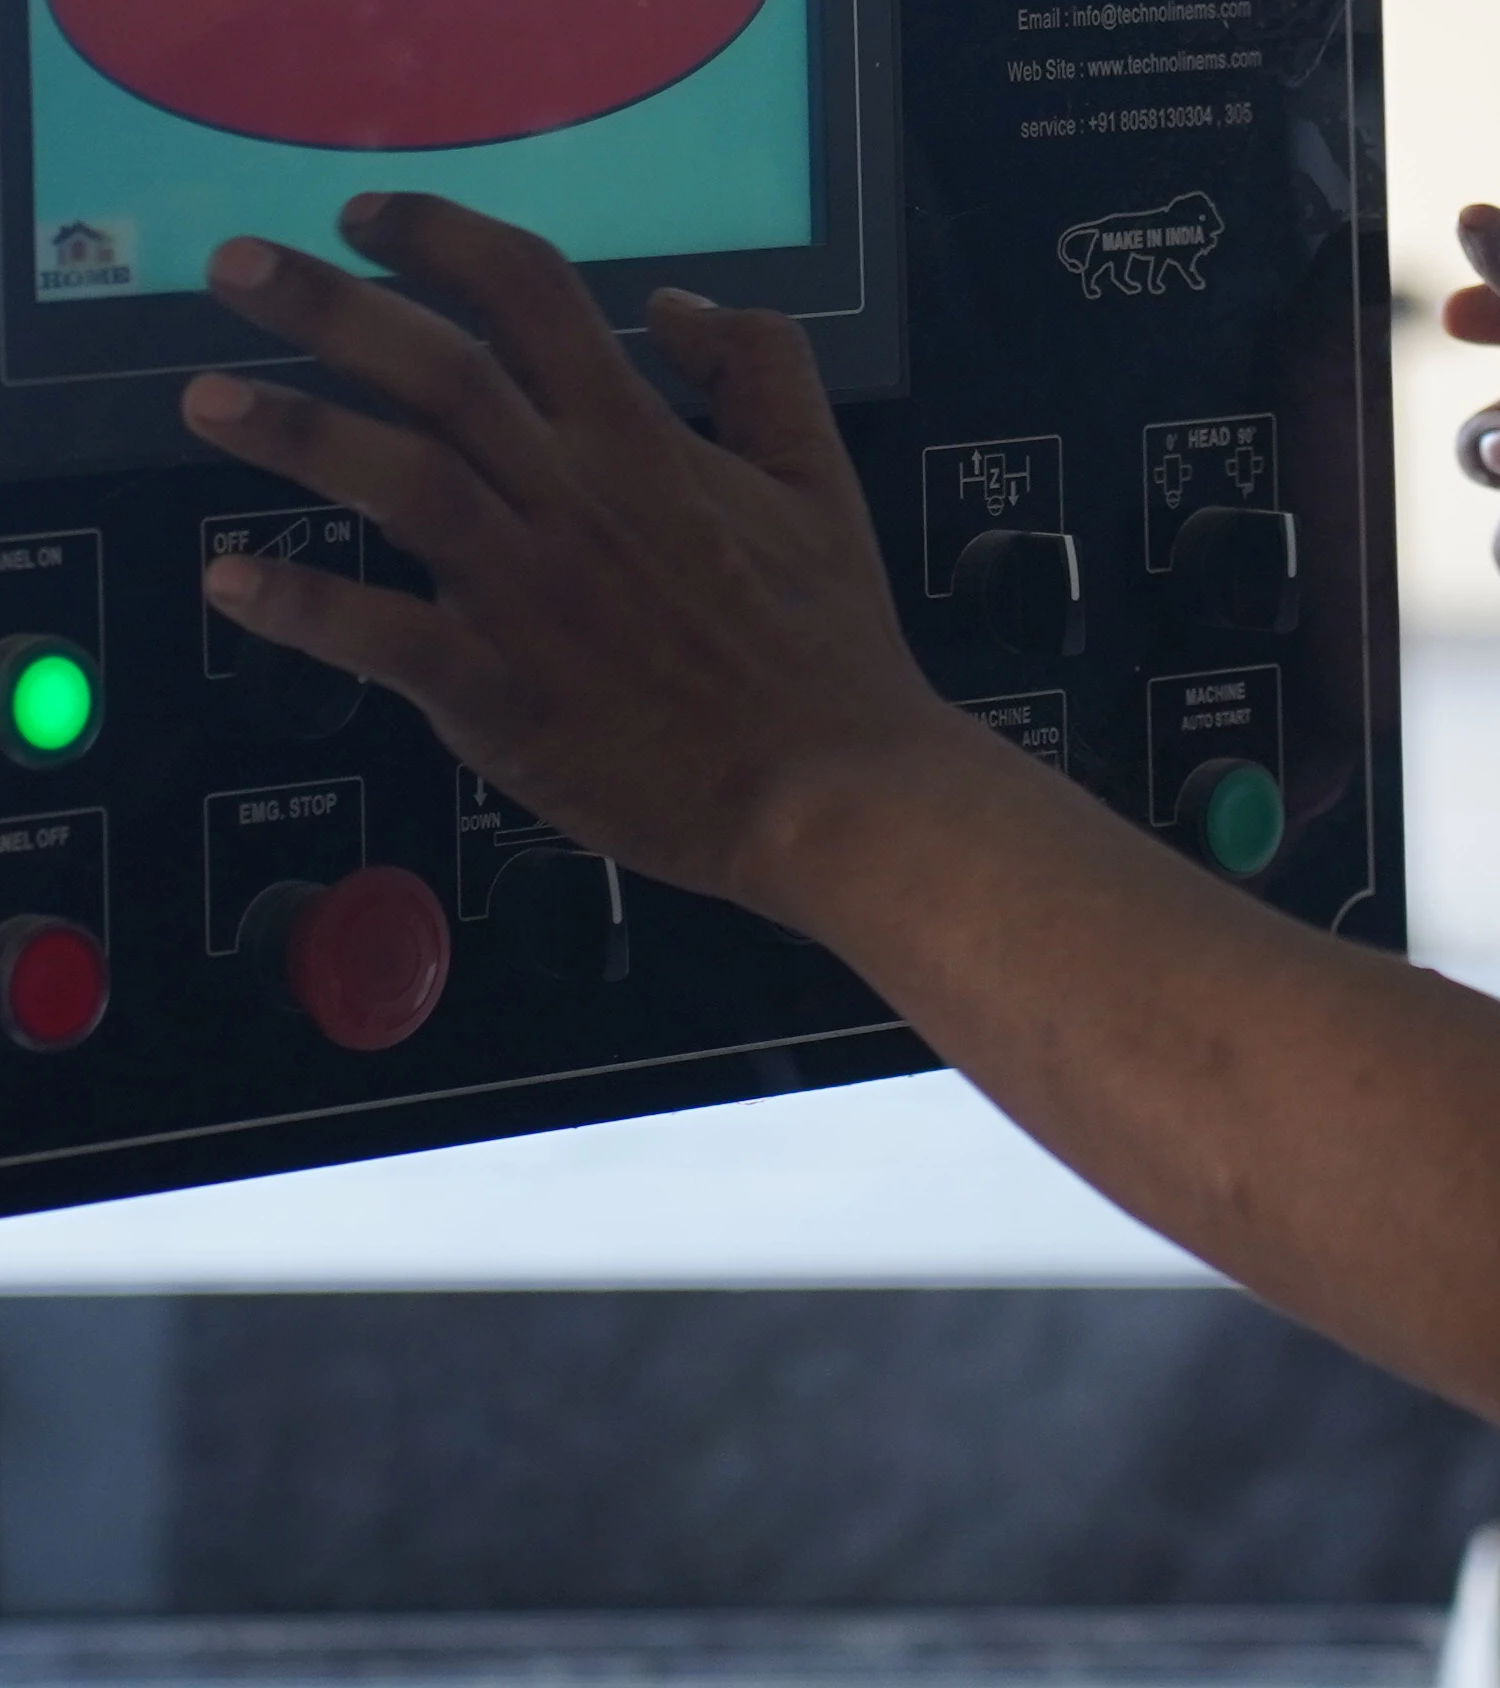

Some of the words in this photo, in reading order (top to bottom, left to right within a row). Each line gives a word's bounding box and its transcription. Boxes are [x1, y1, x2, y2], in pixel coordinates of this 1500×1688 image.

[1018, 8, 1060, 31] Email
[1072, 0, 1252, 31] info@technolinems.com
[1007, 60, 1042, 82] Web
[1045, 58, 1076, 80] Site
[1087, 49, 1262, 77] www.technolinems.com
[1020, 115, 1076, 139] service
[1120, 105, 1212, 132] 8058130304
[1224, 102, 1253, 125] 305
[1102, 230, 1144, 251] MAKE
[1146, 228, 1162, 248] IN
[1165, 225, 1205, 246] INDIA
[41, 264, 130, 290] HOME
[1188, 426, 1231, 448] HEAD
[989, 468, 1000, 489] Z
[213, 530, 249, 554] OFF
[324, 520, 351, 543] ON
[38, 546, 62, 568] ON
[1185, 682, 1246, 706] MACHINE
[1180, 714, 1213, 732] AUTO
[1214, 708, 1252, 728] START
[1022, 727, 1059, 747] AUTO
[239, 799, 285, 825] EMG.
[289, 794, 337, 819] STOP
[460, 812, 501, 833] DOWN
[36, 825, 70, 850] OFF
